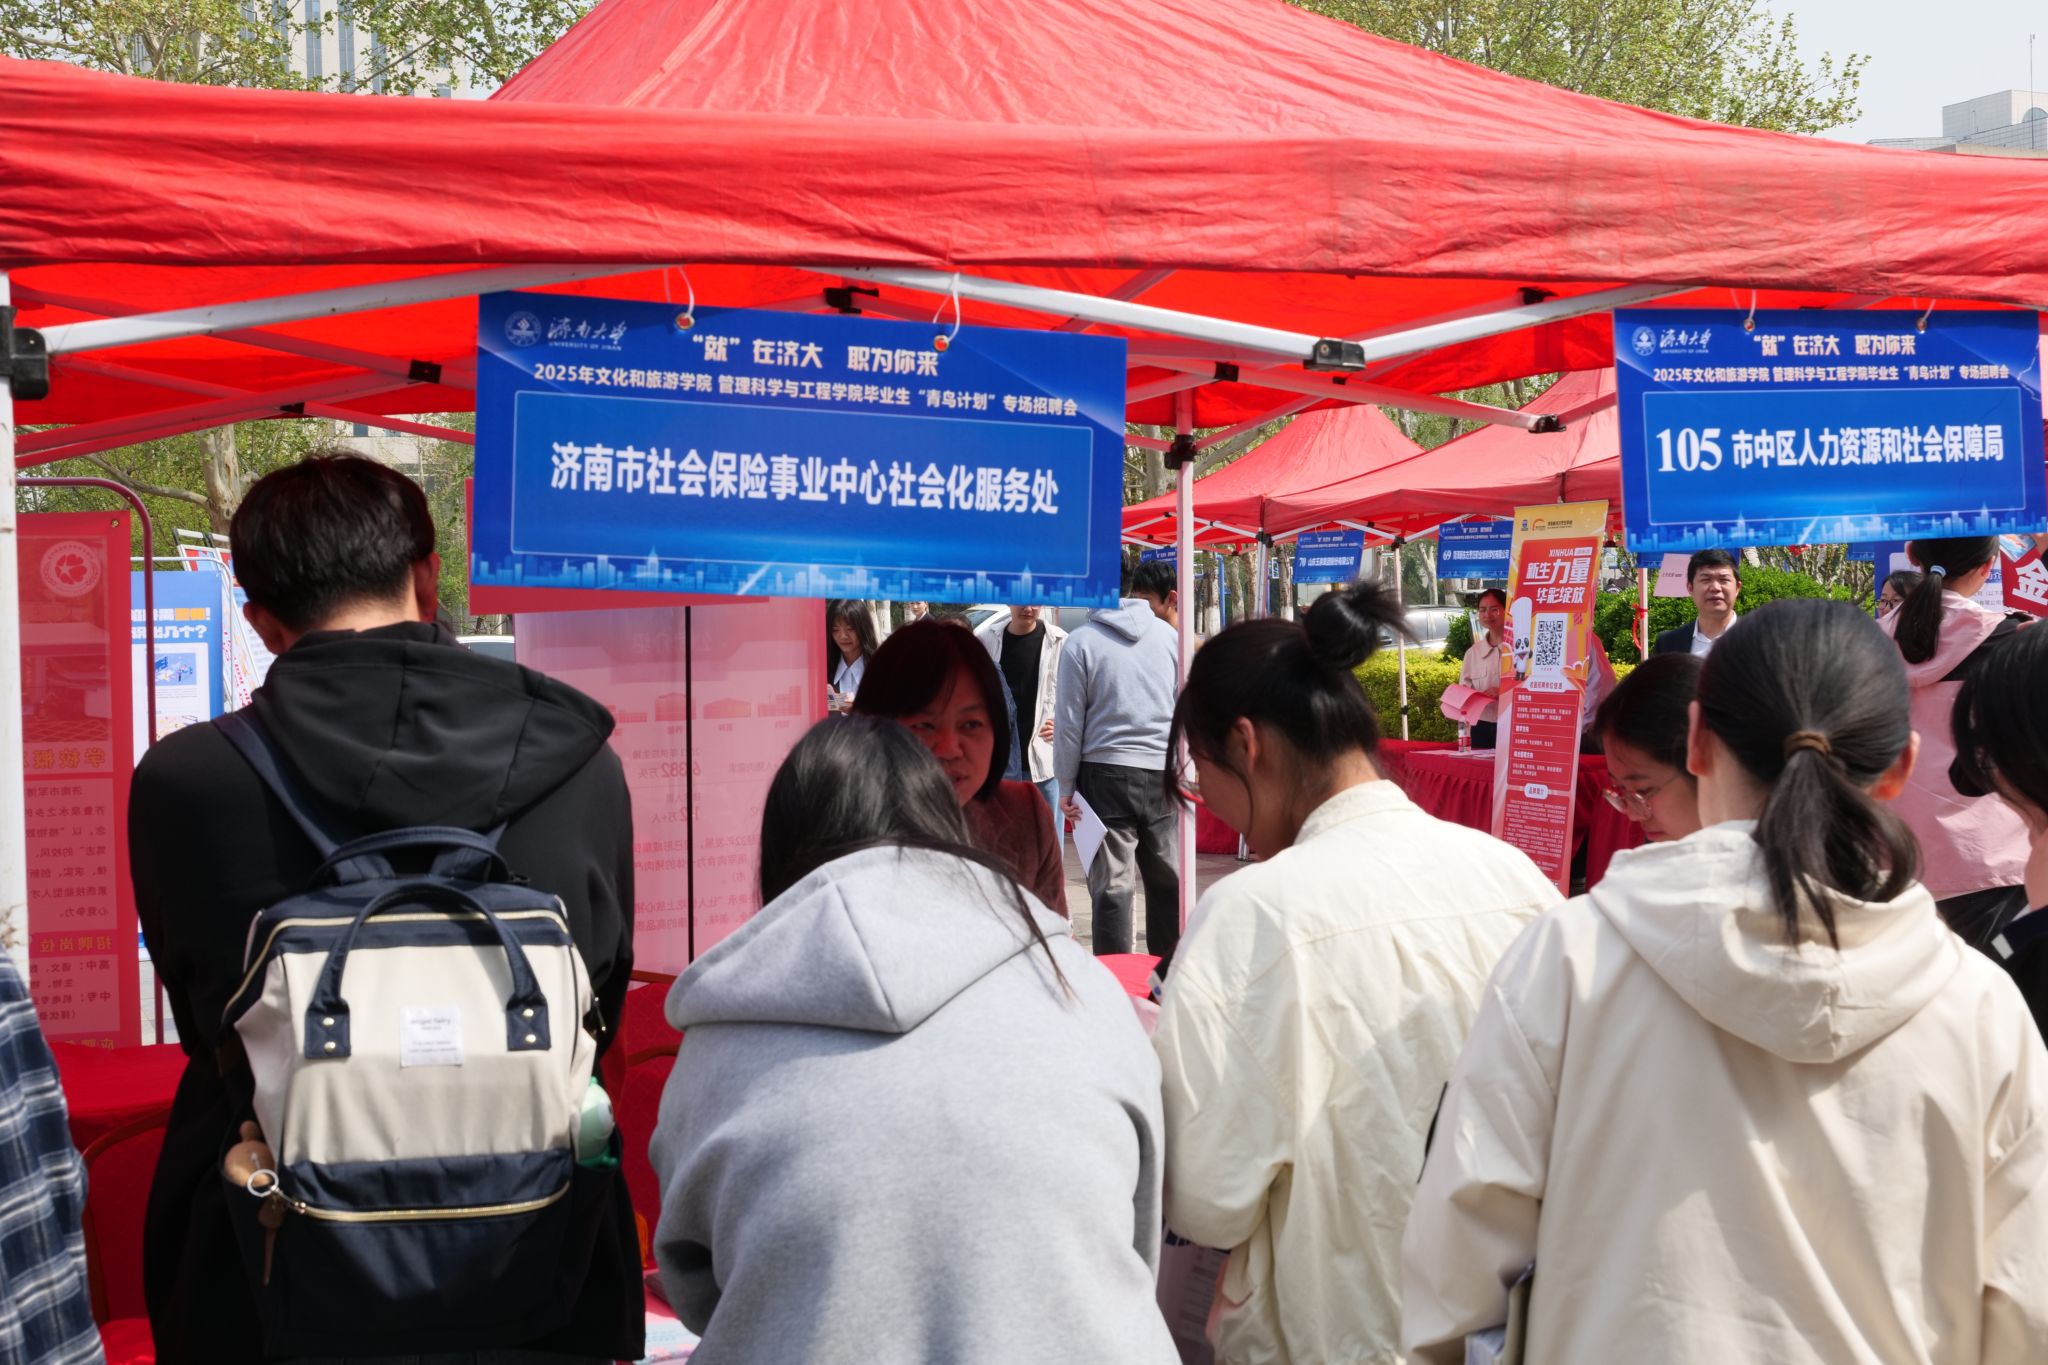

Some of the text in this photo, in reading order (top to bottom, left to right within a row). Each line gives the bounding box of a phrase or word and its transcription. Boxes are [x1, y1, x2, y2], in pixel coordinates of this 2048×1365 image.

[548, 341, 588, 349] UNIVERSITY
[600, 344, 623, 352] JINAN
[1855, 334, 1917, 357] 职为你来
[847, 345, 940, 377] 职为你来
[533, 362, 713, 393] 2025年文化和旅游学院
[1653, 366, 1770, 384] 2025年文化和旅游学院
[1655, 424, 2004, 472] 105 市中区人力资源和社会保障局
[549, 441, 1060, 515] 济南市社会保险事业中心社会化服务处
[1442, 550, 1452, 561] 69
[1549, 549, 1575, 558] XINHUA
[1536, 586, 1586, 604] 华彩绽放
